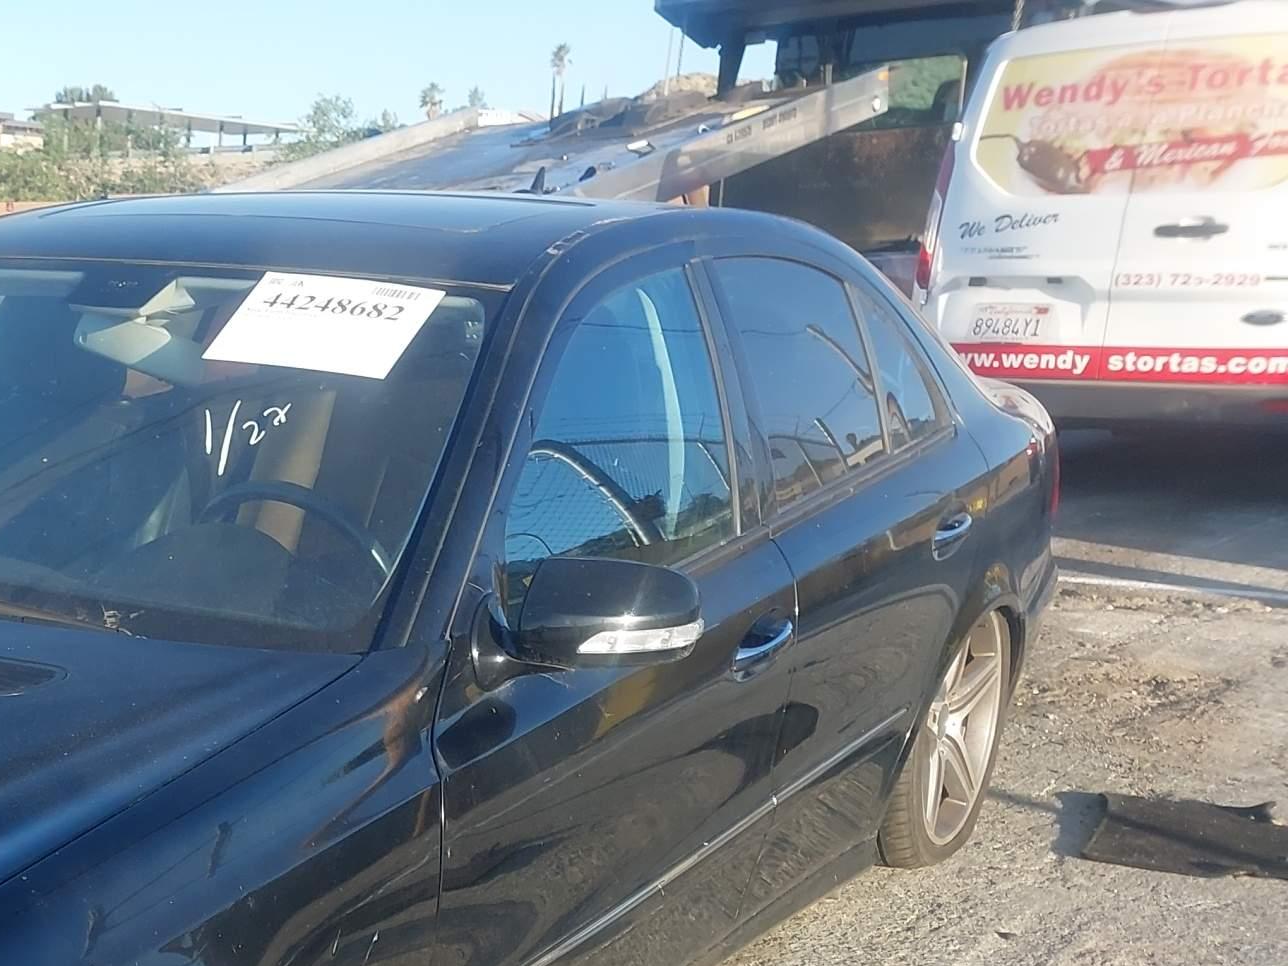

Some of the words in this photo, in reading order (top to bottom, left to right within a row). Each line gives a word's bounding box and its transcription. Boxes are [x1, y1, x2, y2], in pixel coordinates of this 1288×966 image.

[1002, 67, 1165, 112] Wendy's
[1136, 141, 1240, 167] Mexican
[958, 220, 986, 239] We
[993, 212, 1060, 232] Deliver
[1114, 273, 1161, 288] (323)
[263, 291, 406, 320] 44248682
[972, 316, 1041, 338] 89484Y1
